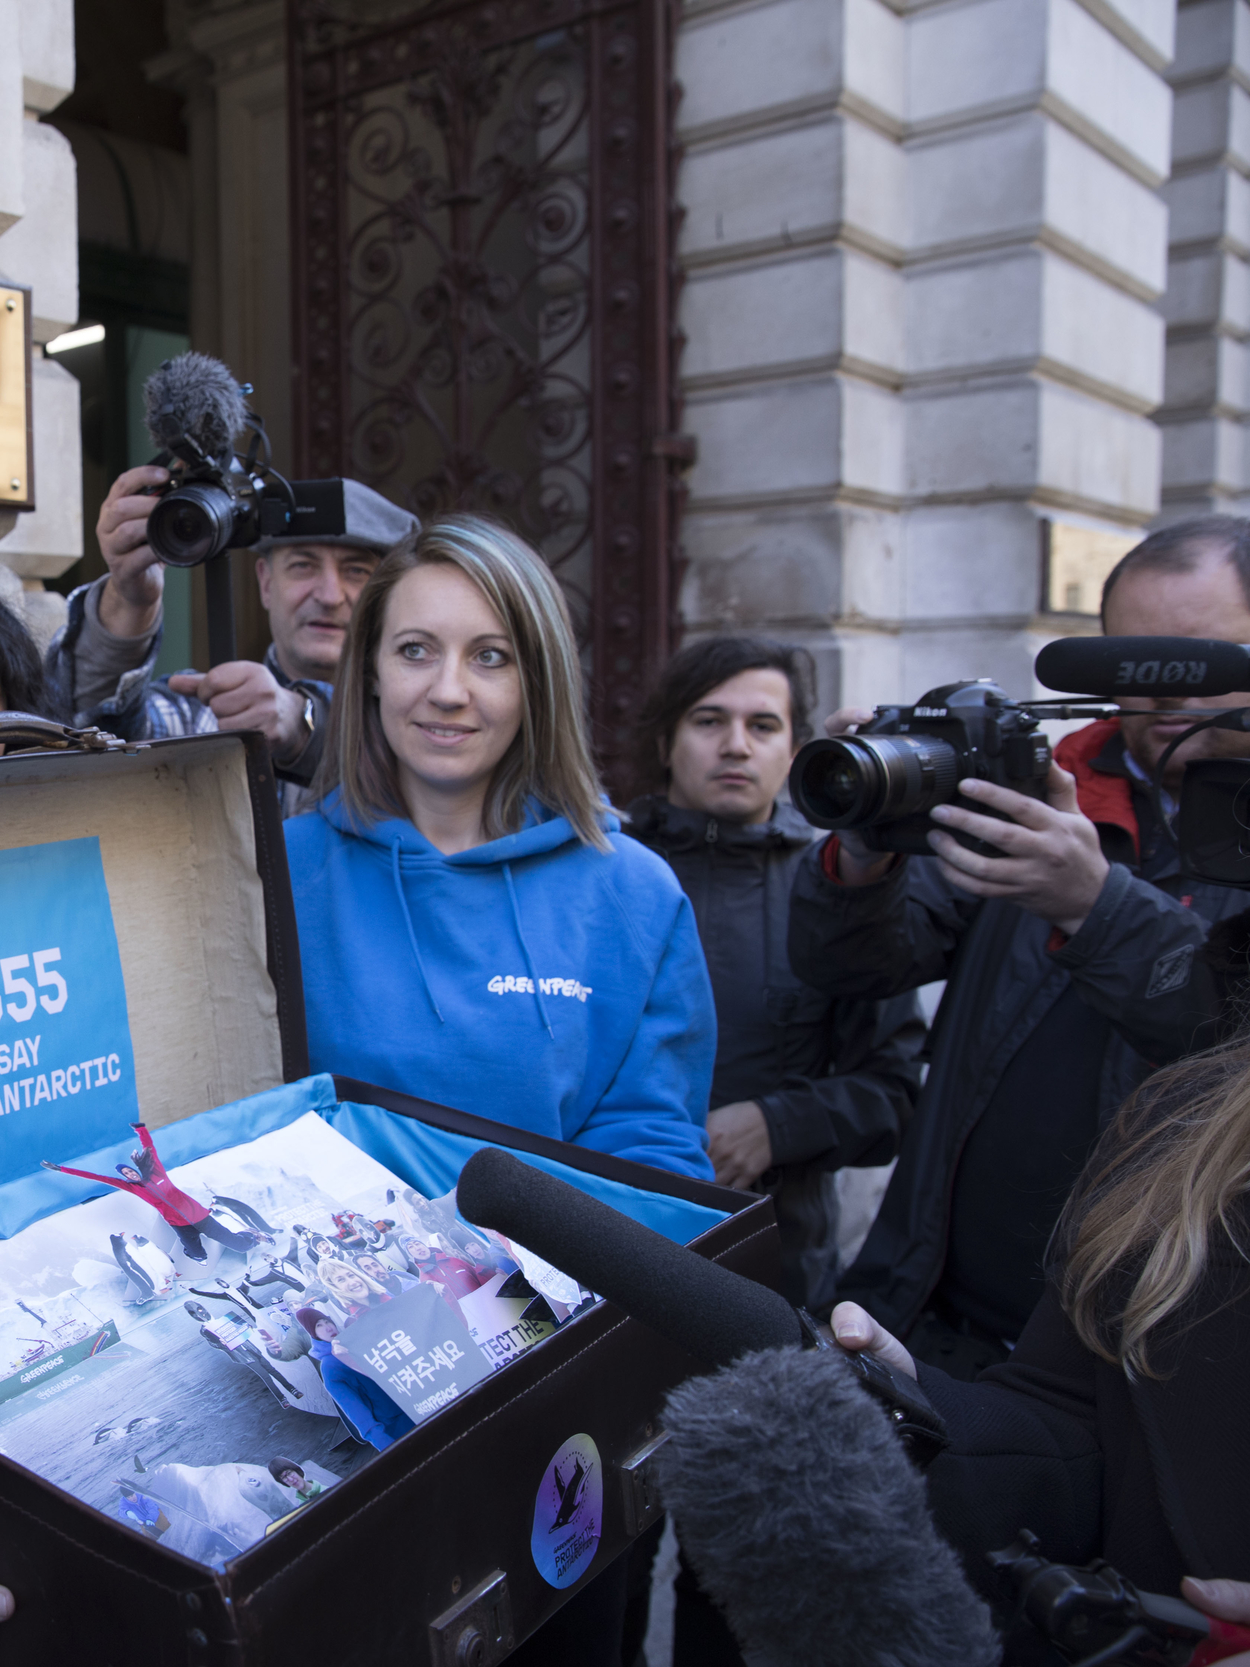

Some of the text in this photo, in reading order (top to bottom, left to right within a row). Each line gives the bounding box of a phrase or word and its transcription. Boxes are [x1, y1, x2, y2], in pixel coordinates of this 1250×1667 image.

[913, 706, 948, 717] Nikon
[20, 1355, 65, 1384] GREENPEACE
[363, 1329, 417, 1374] 남극을
[387, 1340, 465, 1397] 지켜주세요
[555, 1531, 585, 1568] PROTECT
